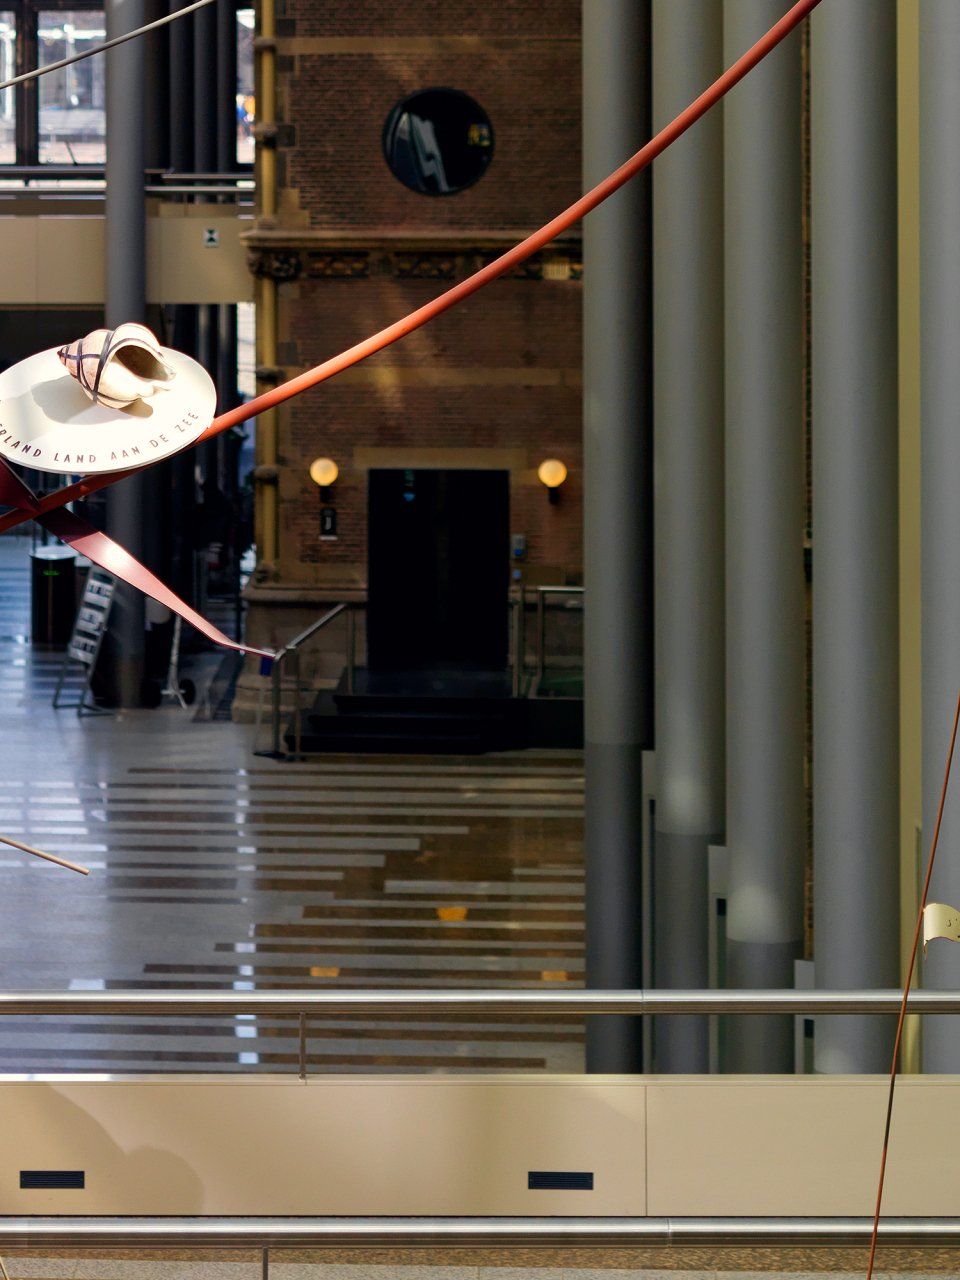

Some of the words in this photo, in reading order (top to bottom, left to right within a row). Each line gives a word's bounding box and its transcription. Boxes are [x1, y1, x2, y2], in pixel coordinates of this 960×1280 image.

[53, 453, 97, 463] LAND
[110, 446, 140, 461] AAN
[149, 434, 169, 448] DE
[175, 412, 199, 433] ZEE
